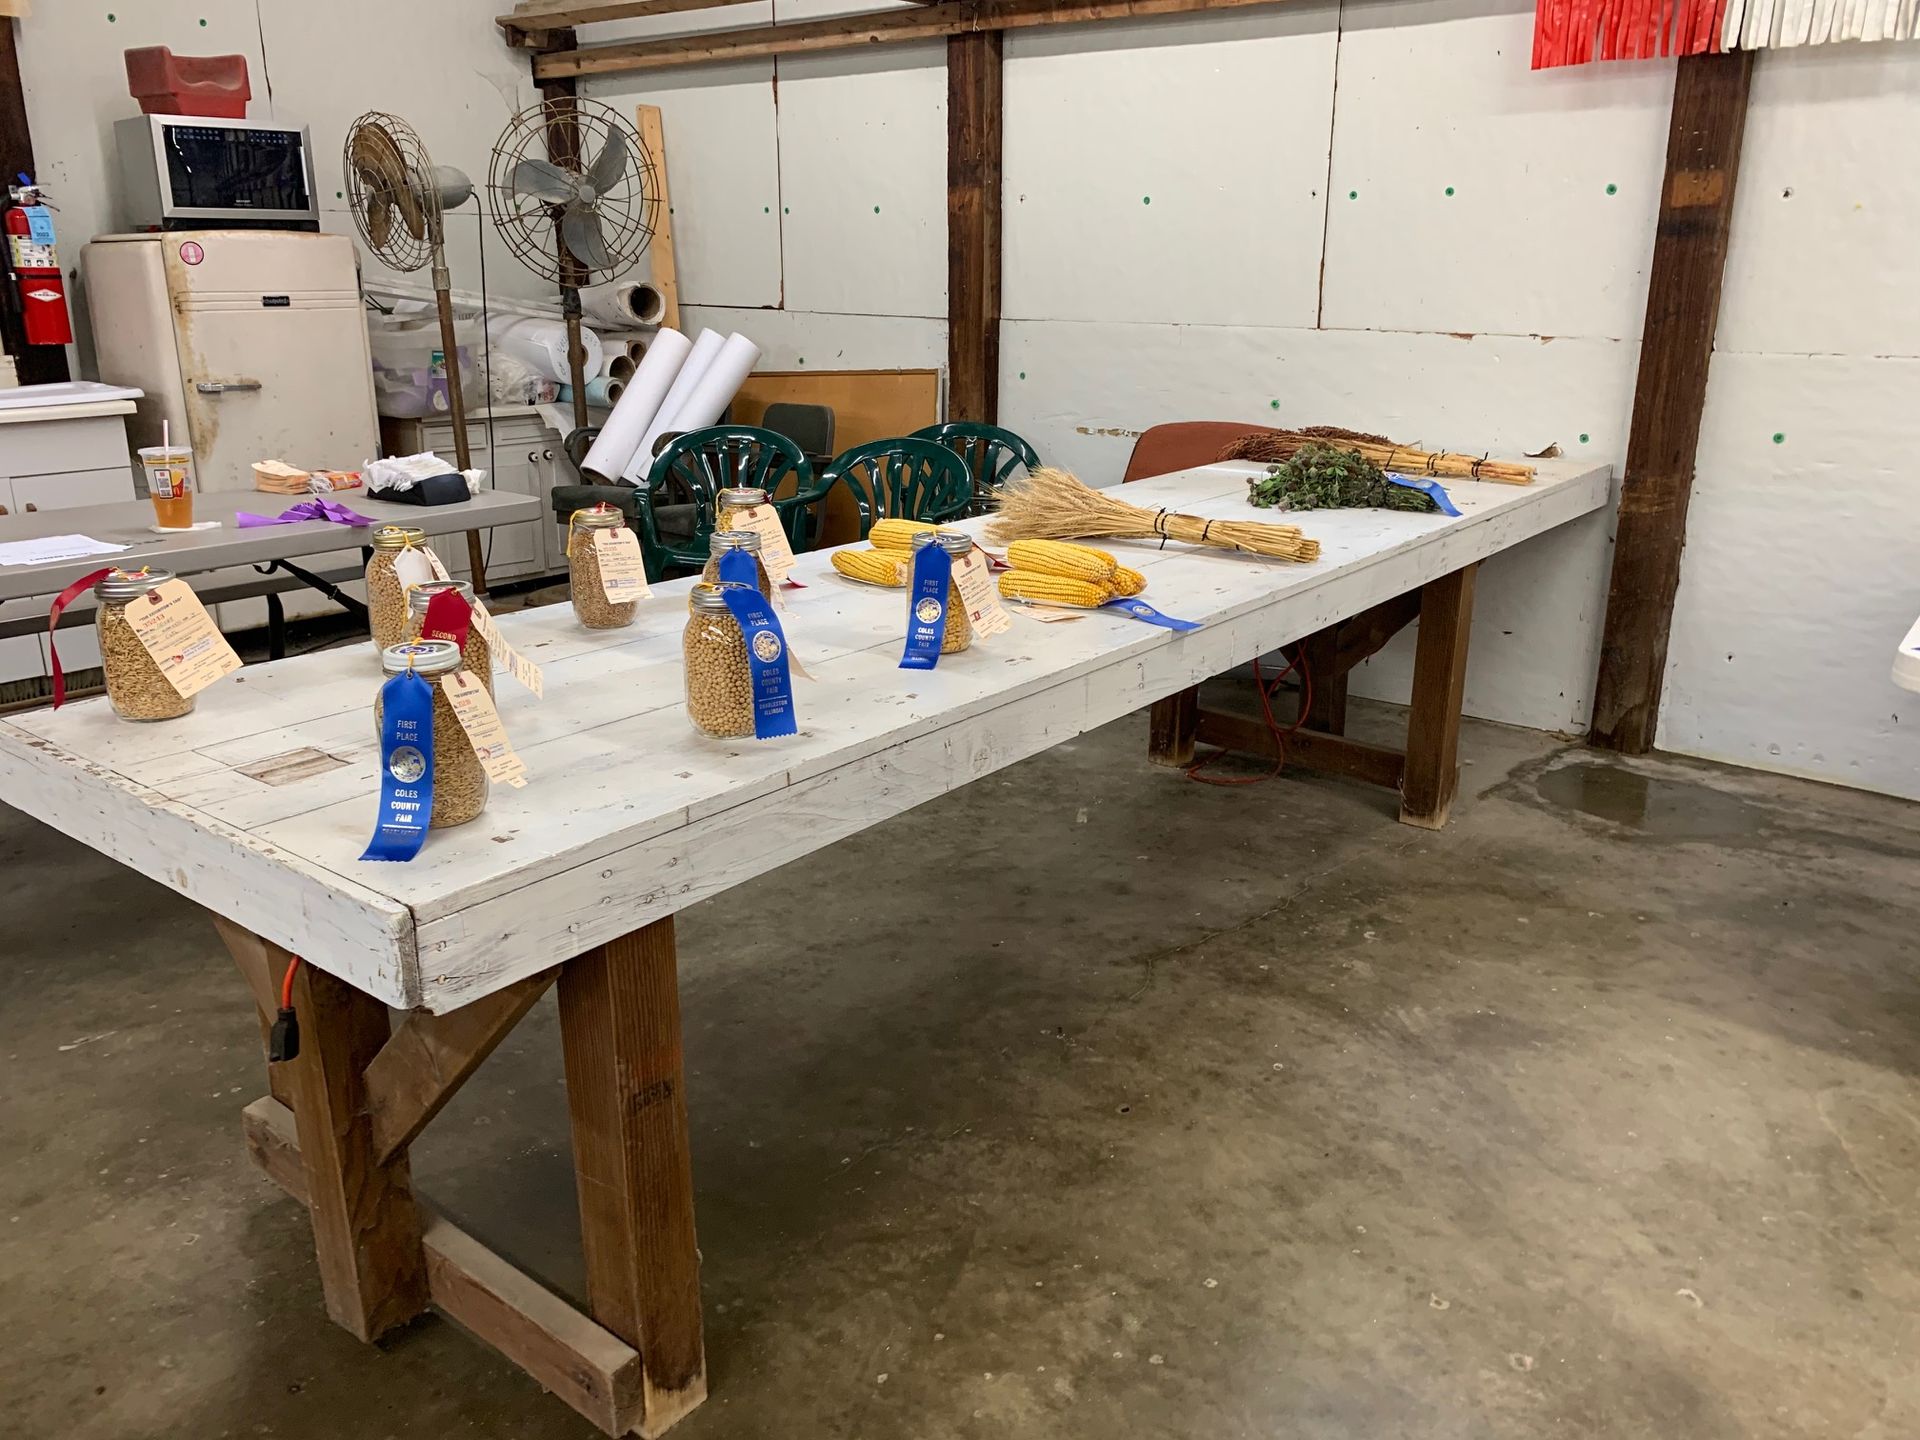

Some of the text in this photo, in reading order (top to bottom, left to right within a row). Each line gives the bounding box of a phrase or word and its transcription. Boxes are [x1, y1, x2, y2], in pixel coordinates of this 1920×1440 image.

[750, 618, 769, 627] PLACE
[431, 629, 457, 641] SECOND
[917, 627, 934, 635] COLES
[762, 667, 780, 677] COLES
[761, 676, 782, 687] COUNTY
[766, 685, 779, 694] FAIR
[397, 719, 418, 730] FIRST
[396, 731, 419, 742] PLACE
[394, 788, 418, 799] COLES
[390, 800, 421, 812] COUNTY
[395, 813, 413, 823] FAIR
